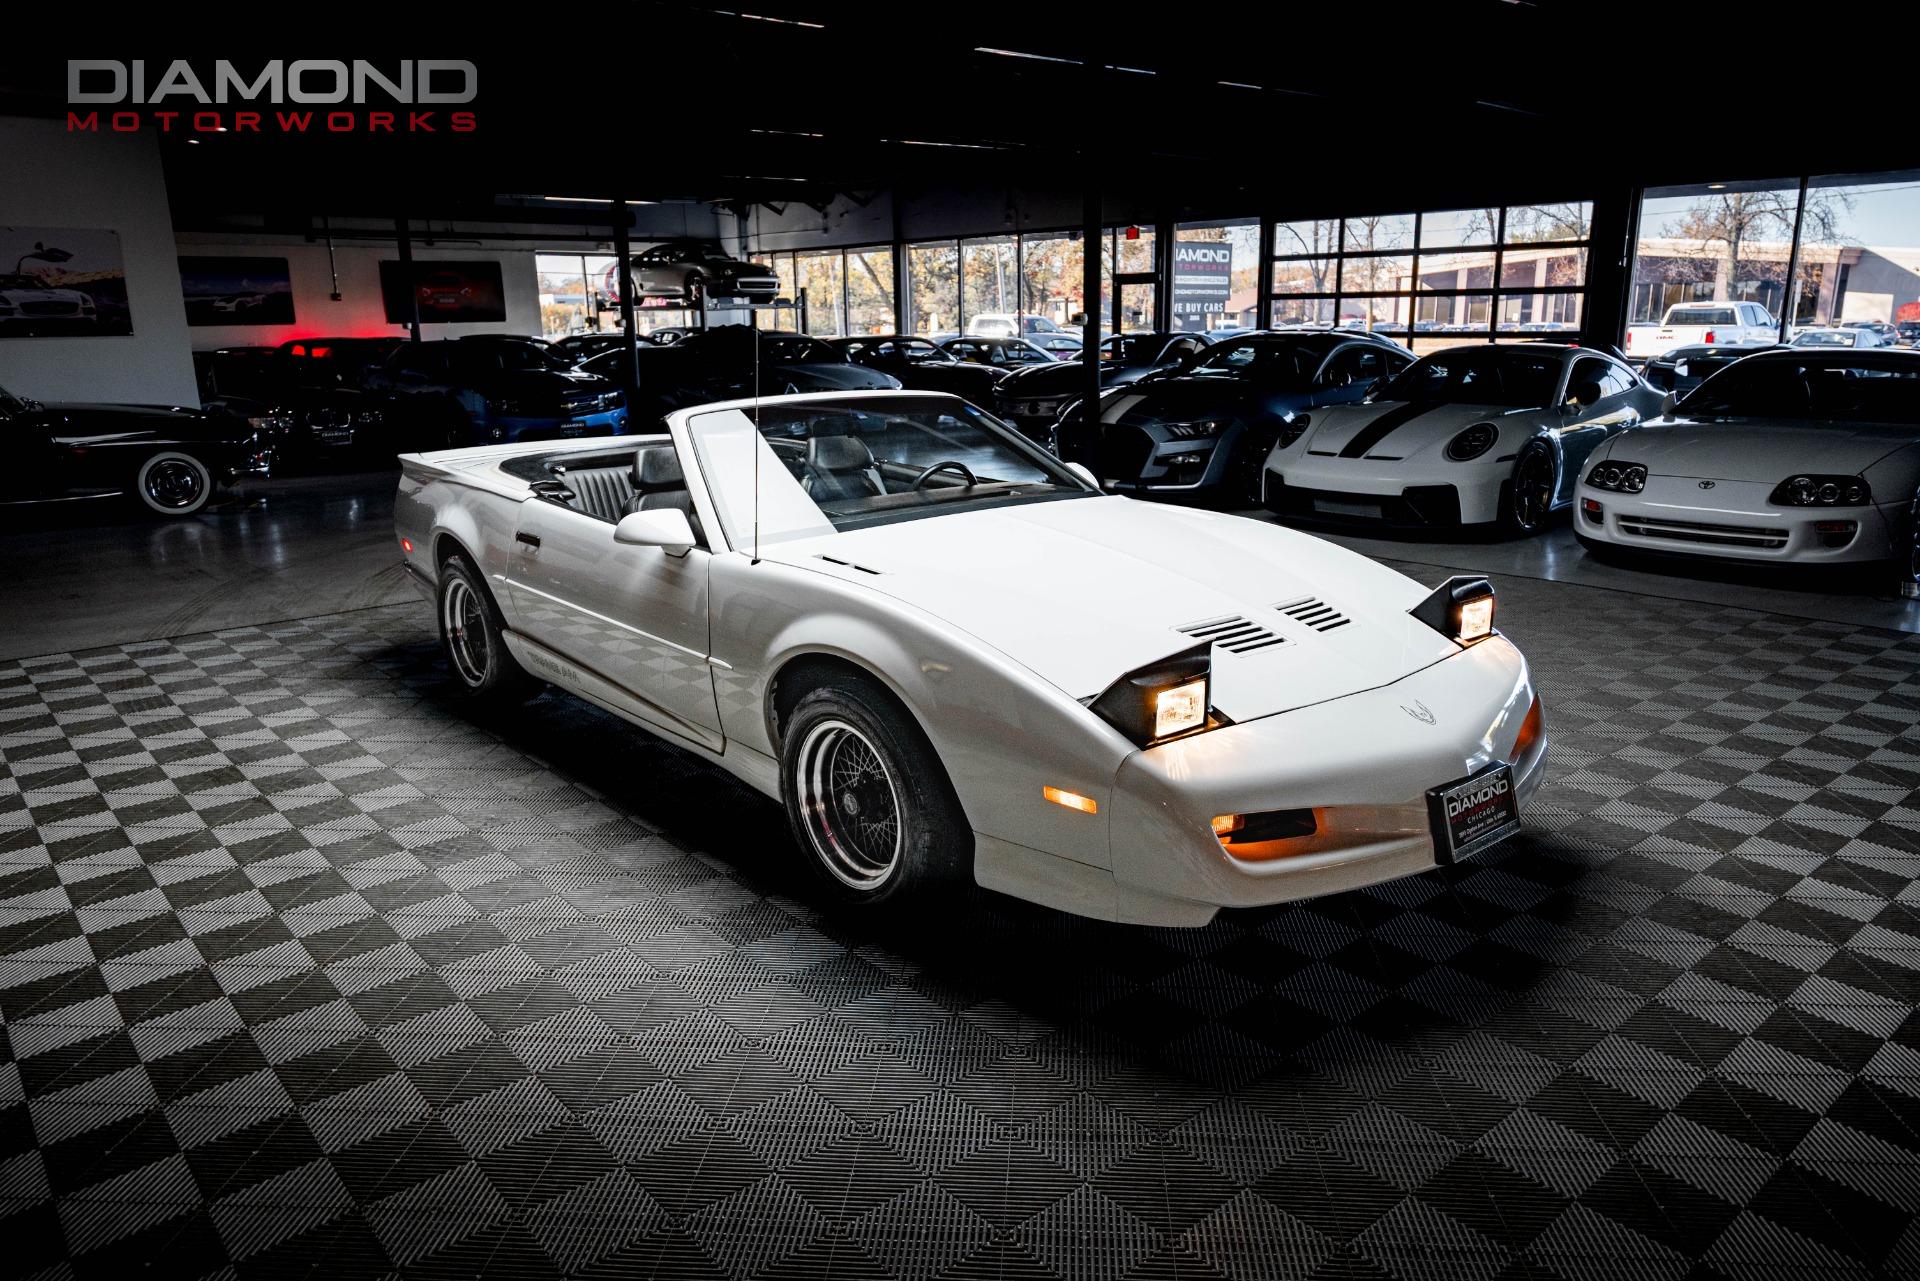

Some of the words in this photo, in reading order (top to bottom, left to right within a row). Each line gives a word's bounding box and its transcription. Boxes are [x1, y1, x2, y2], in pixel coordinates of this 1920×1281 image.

[1175, 248, 1230, 263] IAMOND
[1177, 263, 1229, 272] TORWORKS
[1186, 302, 1201, 313] BUY
[1204, 302, 1224, 313] CARS
[1448, 779, 1509, 818] DIAMOND
[1467, 805, 1496, 824] CHICAGO
